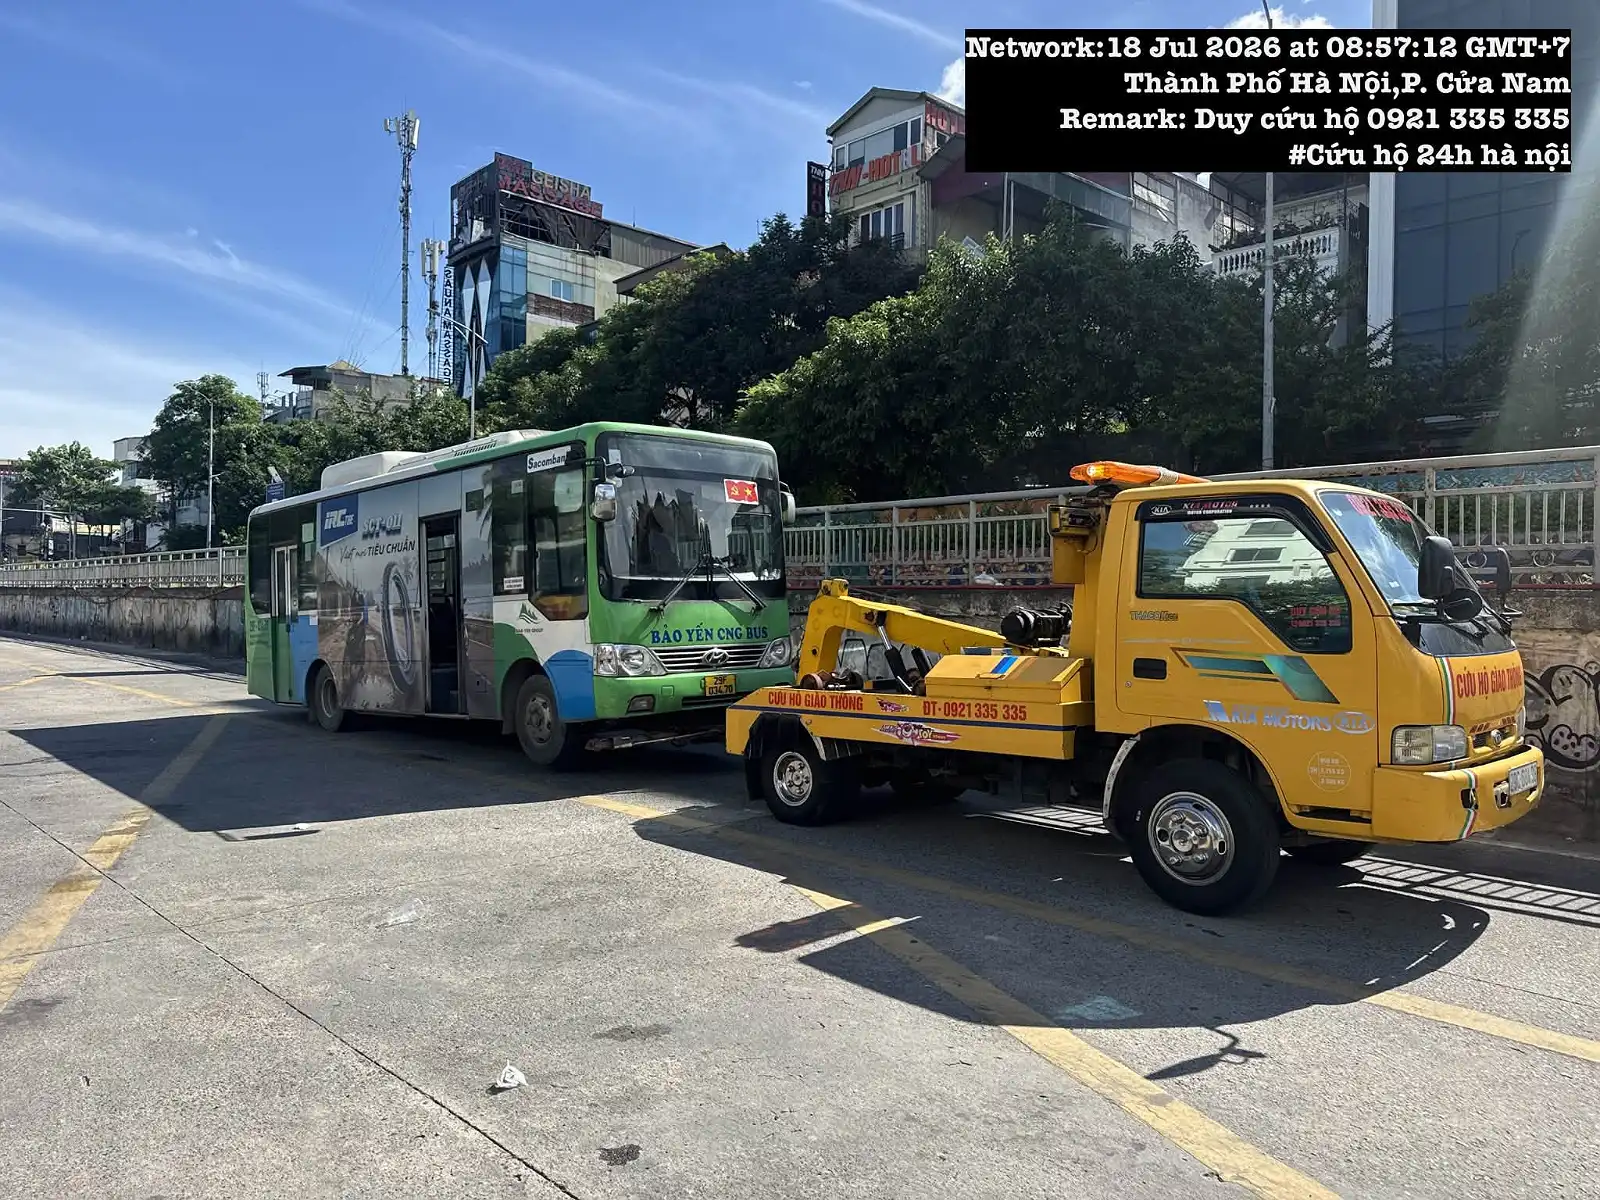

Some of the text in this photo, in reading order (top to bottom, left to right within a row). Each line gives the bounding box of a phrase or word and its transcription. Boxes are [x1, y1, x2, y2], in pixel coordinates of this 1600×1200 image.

[531, 170, 590, 198] GEISHA
[528, 453, 566, 469] Sacomban
[651, 623, 768, 644] BẢO YẾN CNG BUS
[1456, 666, 1476, 698] CỨU
[1478, 665, 1489, 700] HỘ
[974, 703, 998, 719] 335
[1002, 704, 1027, 721] 335
[1262, 713, 1331, 732] MOTORS
[1337, 715, 1370, 731] KIA
